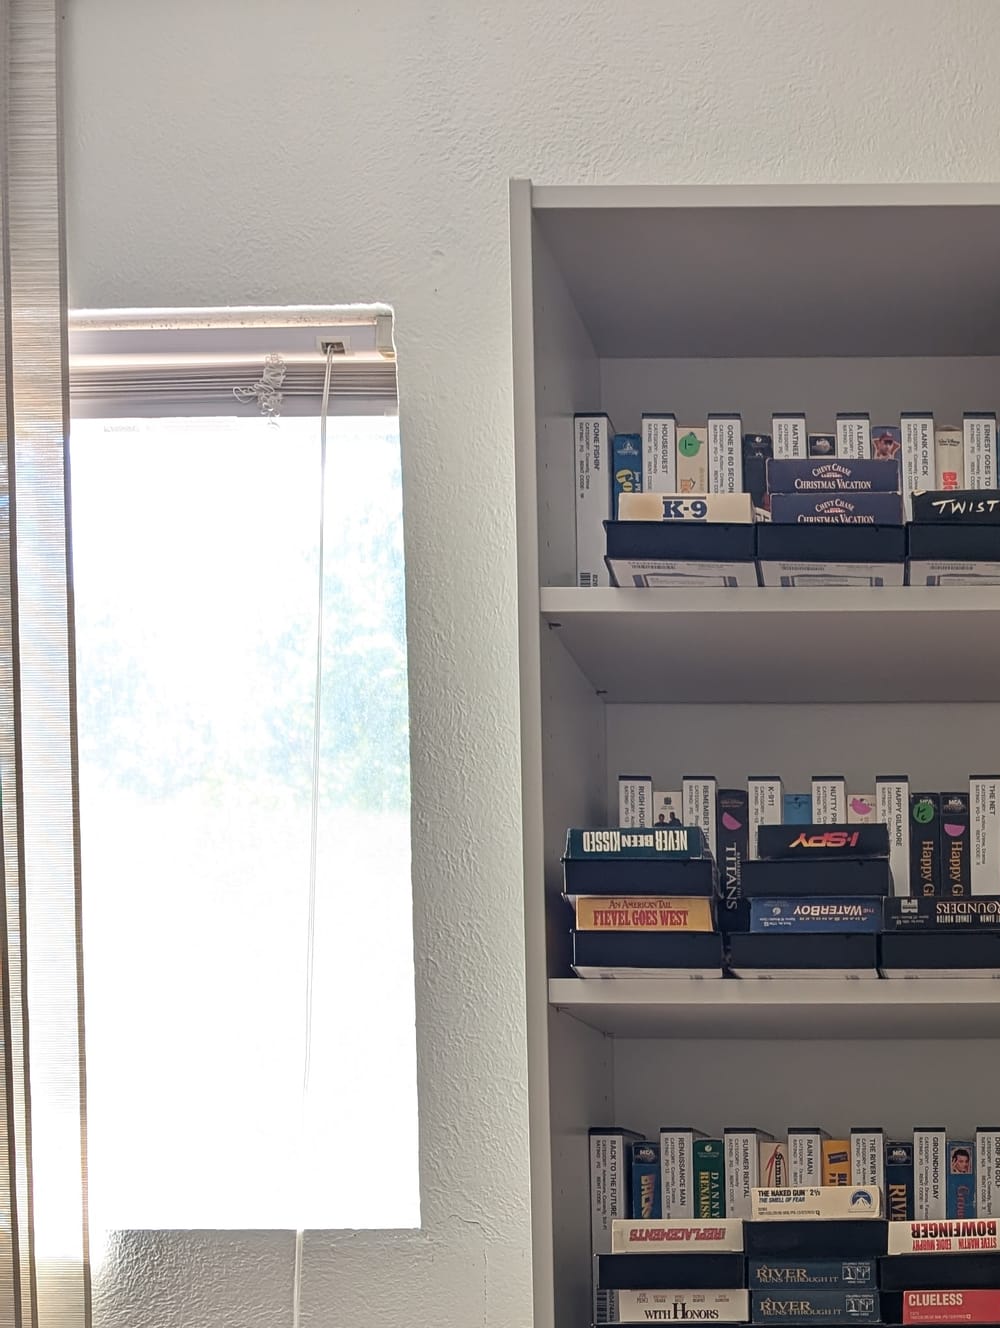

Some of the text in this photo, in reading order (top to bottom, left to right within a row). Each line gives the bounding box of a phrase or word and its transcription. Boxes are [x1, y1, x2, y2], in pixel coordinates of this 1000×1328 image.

[661, 423, 669, 474] HOUSEGUEST
[794, 478, 872, 490] CHRISTMAS VACATION
[662, 500, 708, 519] K-9
[798, 513, 875, 524] CHRISTMAS VACATION
[583, 830, 688, 853] NEVER BEEN KISSED
[920, 840, 934, 881] Happy
[949, 841, 963, 882] Happy
[725, 843, 738, 910] TITANS
[608, 899, 672, 909] AN AMERICAN TAIL
[793, 905, 862, 916] WATERBOY
[593, 909, 689, 927] FIEVEL GOES WEST
[711, 1172, 720, 1219] DANNY
[771, 1189, 791, 1197] NAKED
[792, 1189, 806, 1197] GUN
[630, 1228, 726, 1242] REPLACEMENTS
[911, 1221, 997, 1238] BOWFINGER
[912, 1238, 997, 1251] STEVE MARTIN EDDIE MURPHY
[757, 1268, 807, 1279] RIVER
[760, 1301, 811, 1311] RIVER
[908, 1293, 963, 1306] CLUELESS
[644, 1302, 719, 1320] WITH HONORS
